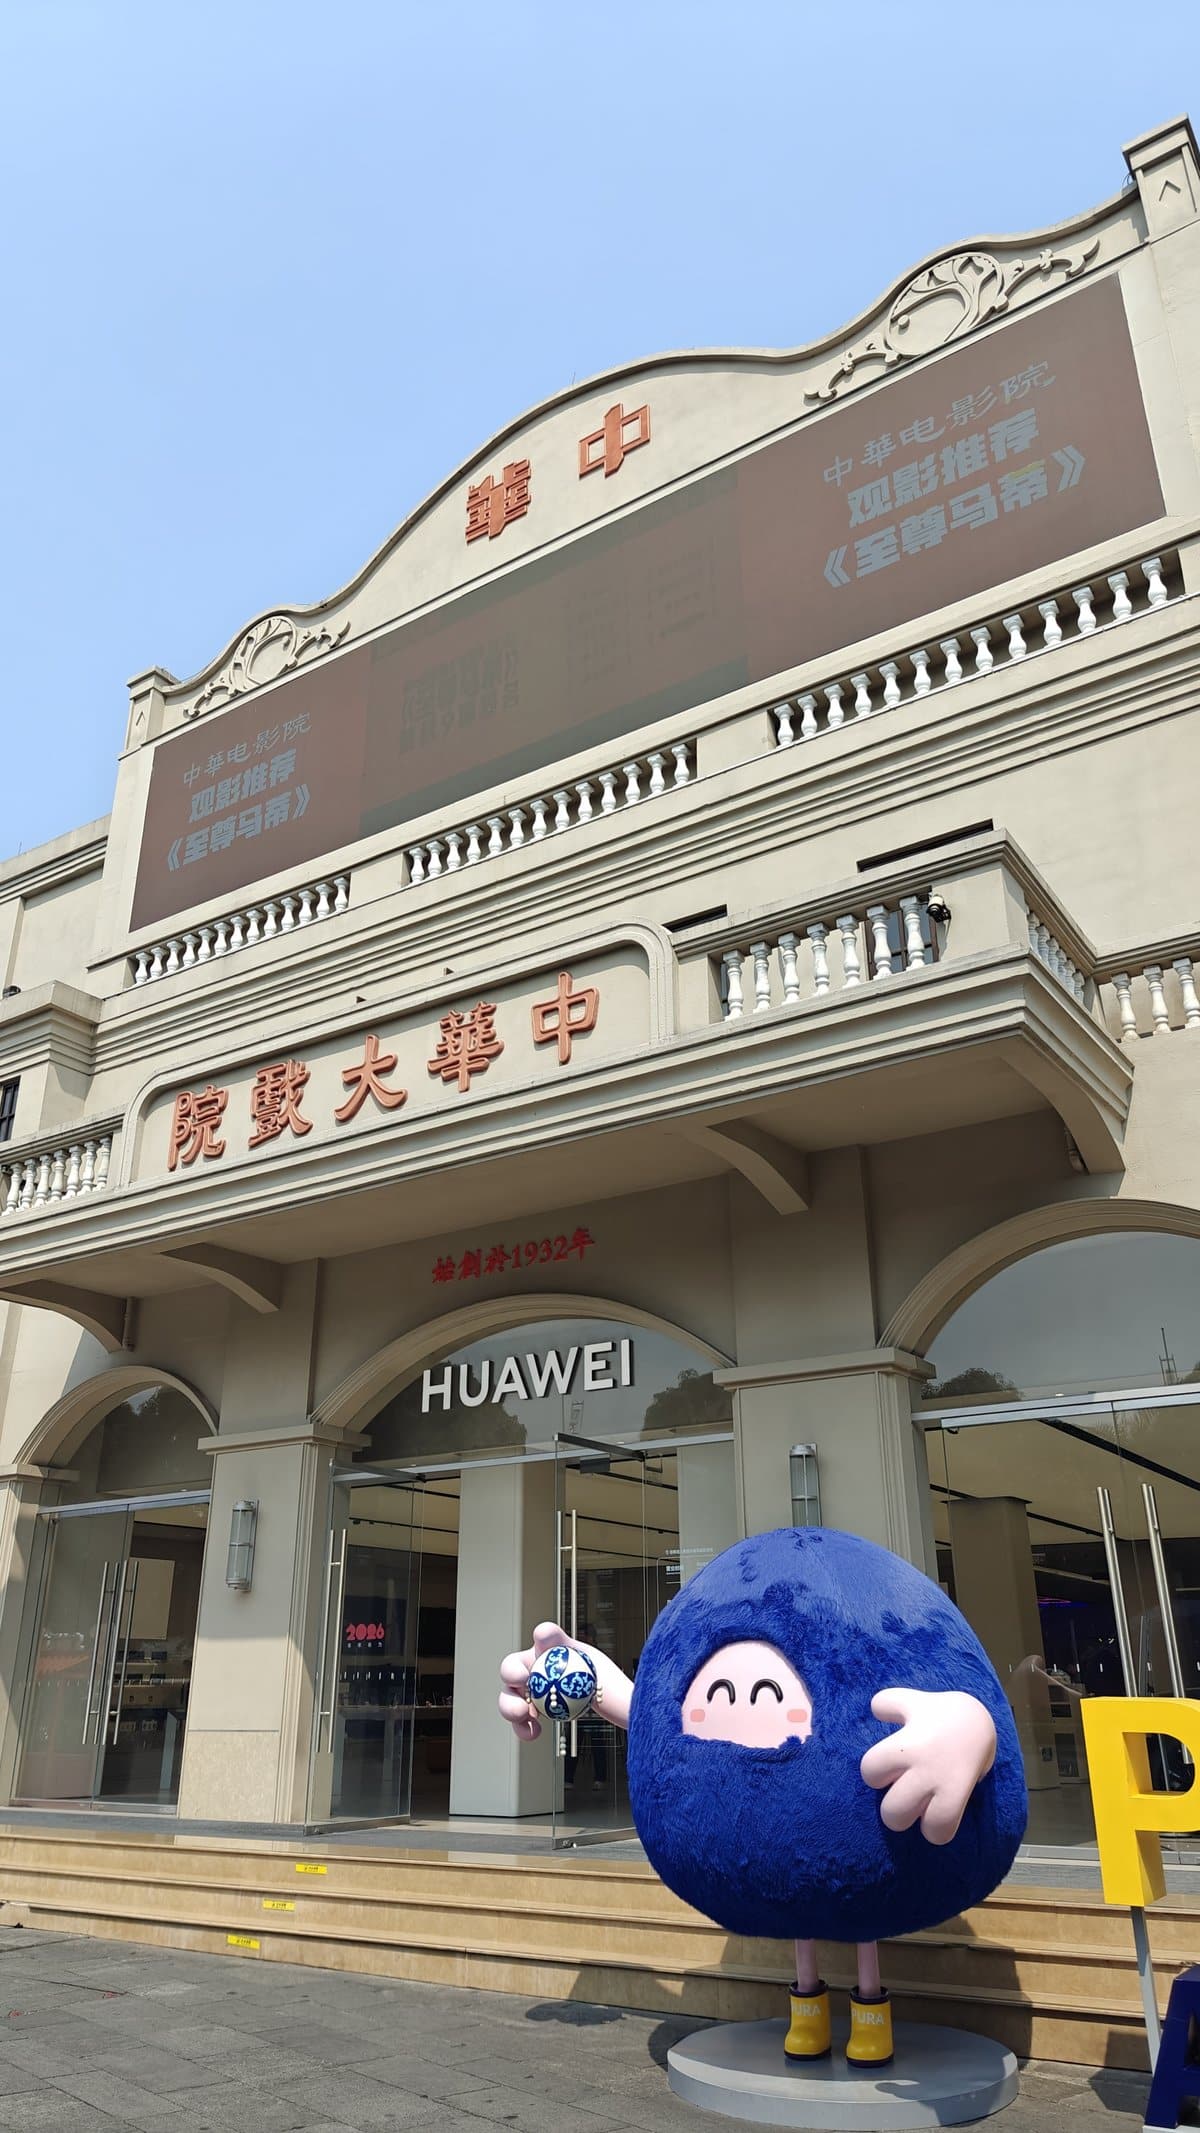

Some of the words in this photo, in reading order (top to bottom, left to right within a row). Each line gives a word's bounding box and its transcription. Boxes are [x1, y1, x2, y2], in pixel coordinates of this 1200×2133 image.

[847, 407, 1040, 528] 观影推荐
[823, 443, 1086, 588] 《至尊马蒂》
[167, 783, 311, 872] 《至尊马蒂》
[189, 748, 297, 824] 观影推荐
[421, 1338, 634, 1413] HUAWEI
